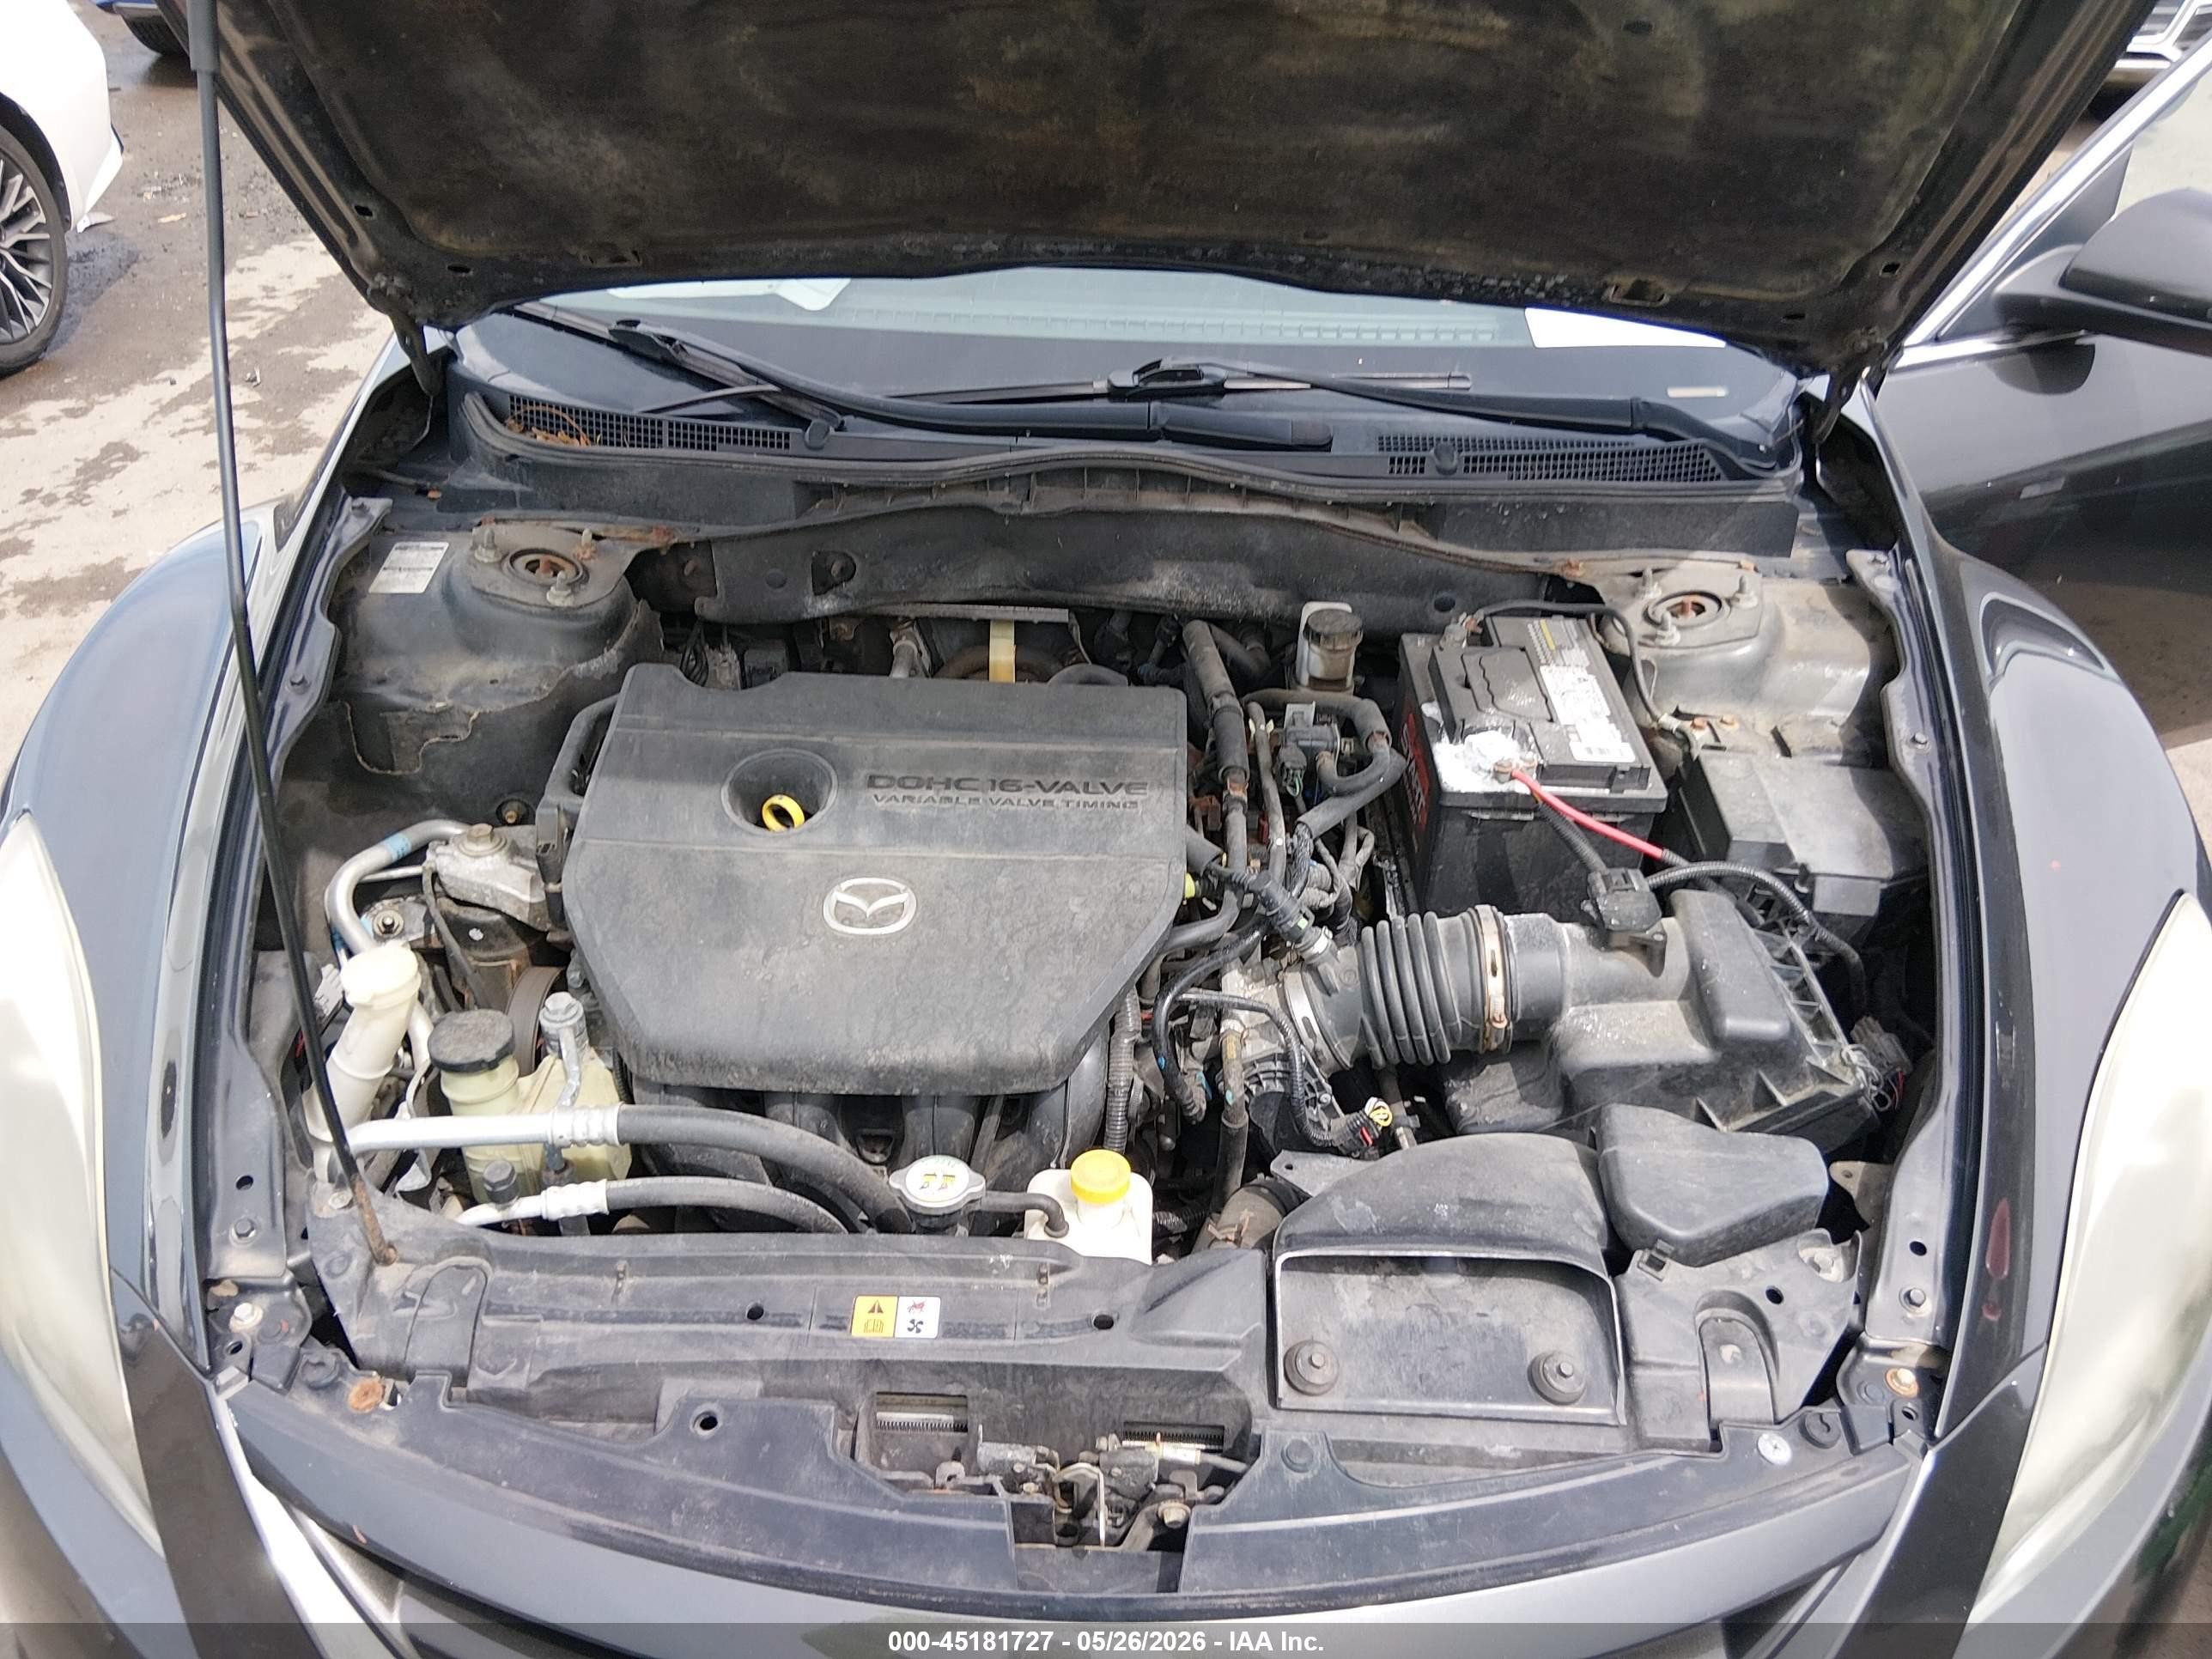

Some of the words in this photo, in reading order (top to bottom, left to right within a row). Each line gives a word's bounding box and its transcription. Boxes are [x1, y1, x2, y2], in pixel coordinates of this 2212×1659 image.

[866, 774, 981, 792] DOHC
[990, 778, 1149, 795] 16-VALVE
[872, 793, 981, 805] VARIABLE
[988, 797, 1055, 808] VALVE
[1063, 799, 1139, 810] TIMING
